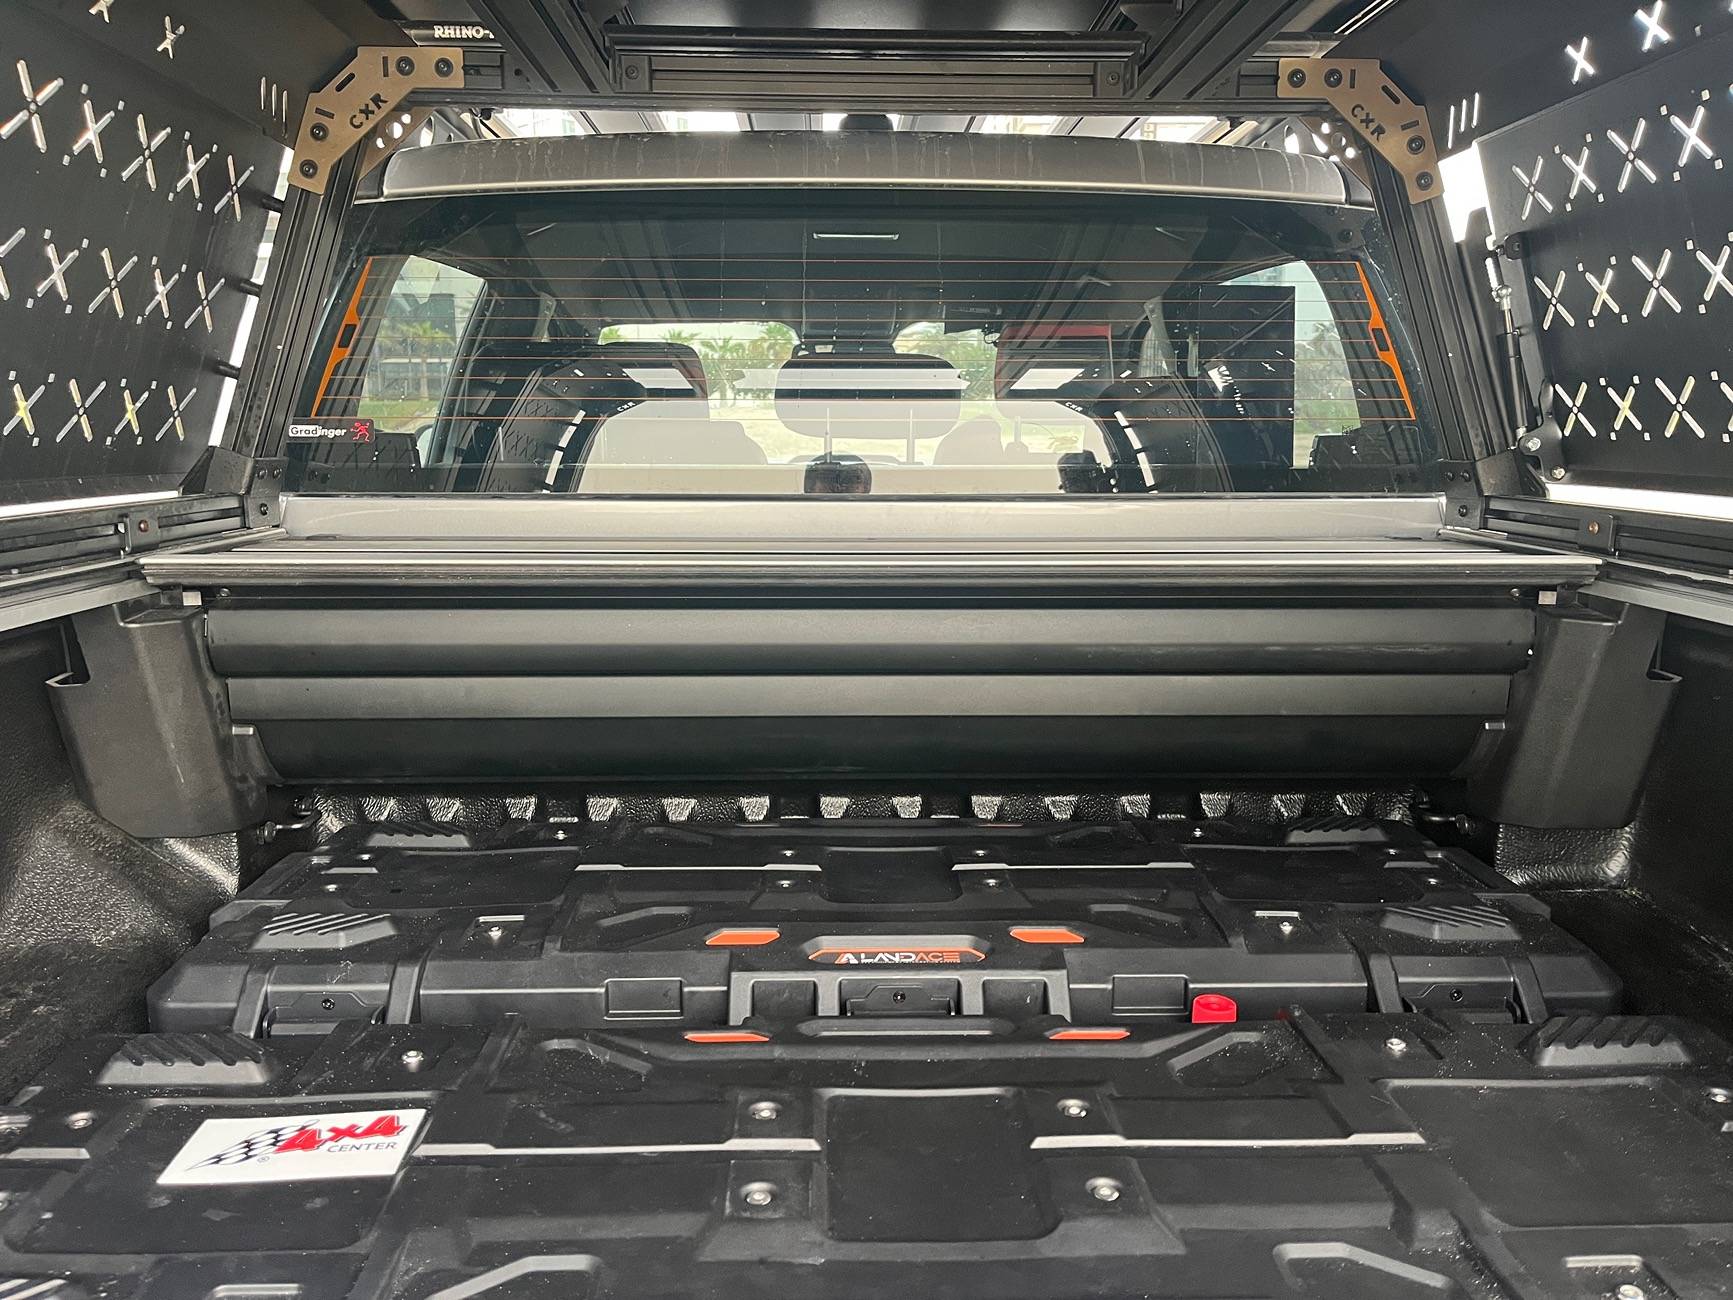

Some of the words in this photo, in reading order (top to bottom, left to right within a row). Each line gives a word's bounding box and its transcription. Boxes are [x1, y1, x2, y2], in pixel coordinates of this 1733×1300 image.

[349, 92, 389, 130] CXR
[1351, 104, 1386, 142] CXR
[289, 425, 347, 438] Gradinger
[273, 1115, 404, 1154] 4x4
[327, 1142, 398, 1153] CENTER
